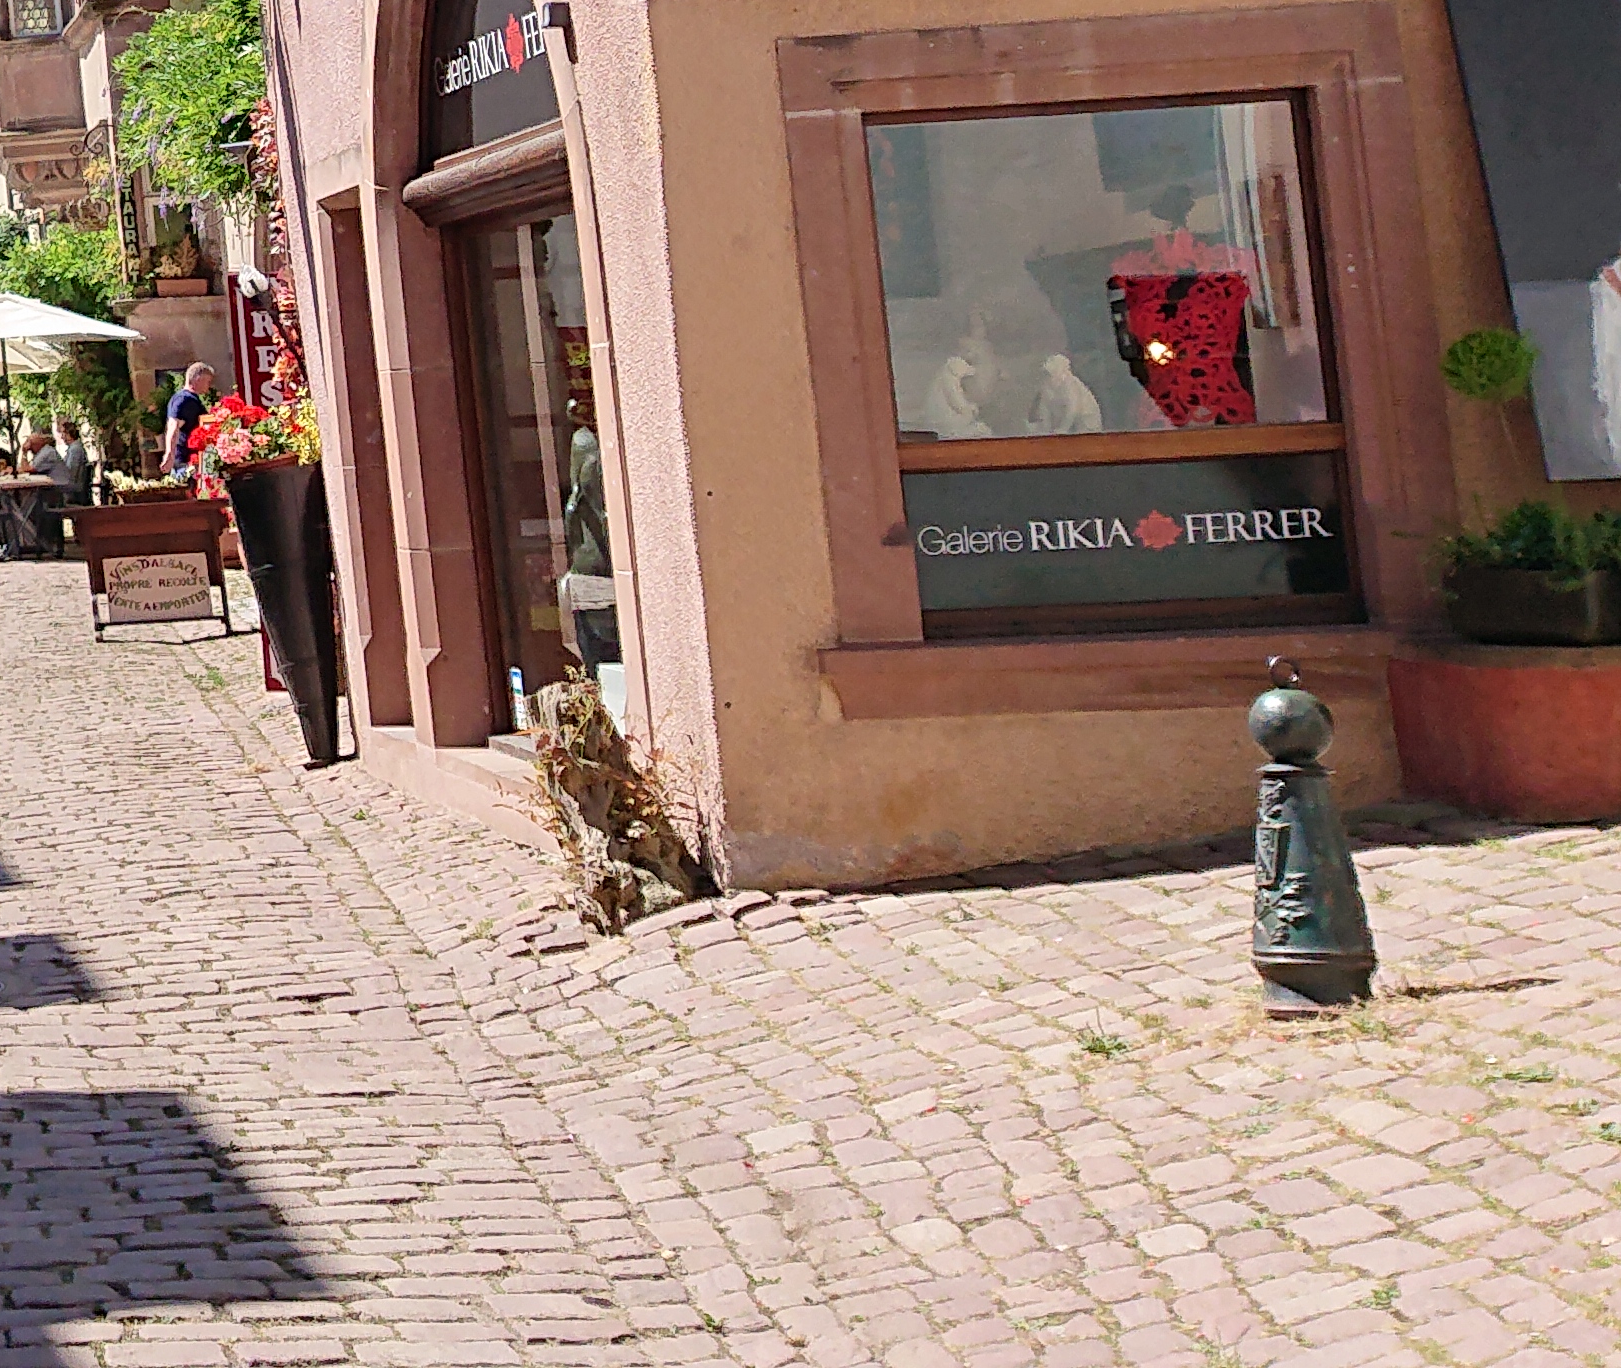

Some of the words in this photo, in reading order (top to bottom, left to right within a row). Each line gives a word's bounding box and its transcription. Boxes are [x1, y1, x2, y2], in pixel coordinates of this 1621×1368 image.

[468, 28, 510, 83] RIKIA
[917, 523, 1025, 556] Galerie
[1028, 516, 1135, 552] RIKIA
[1184, 507, 1334, 545] FERRER
